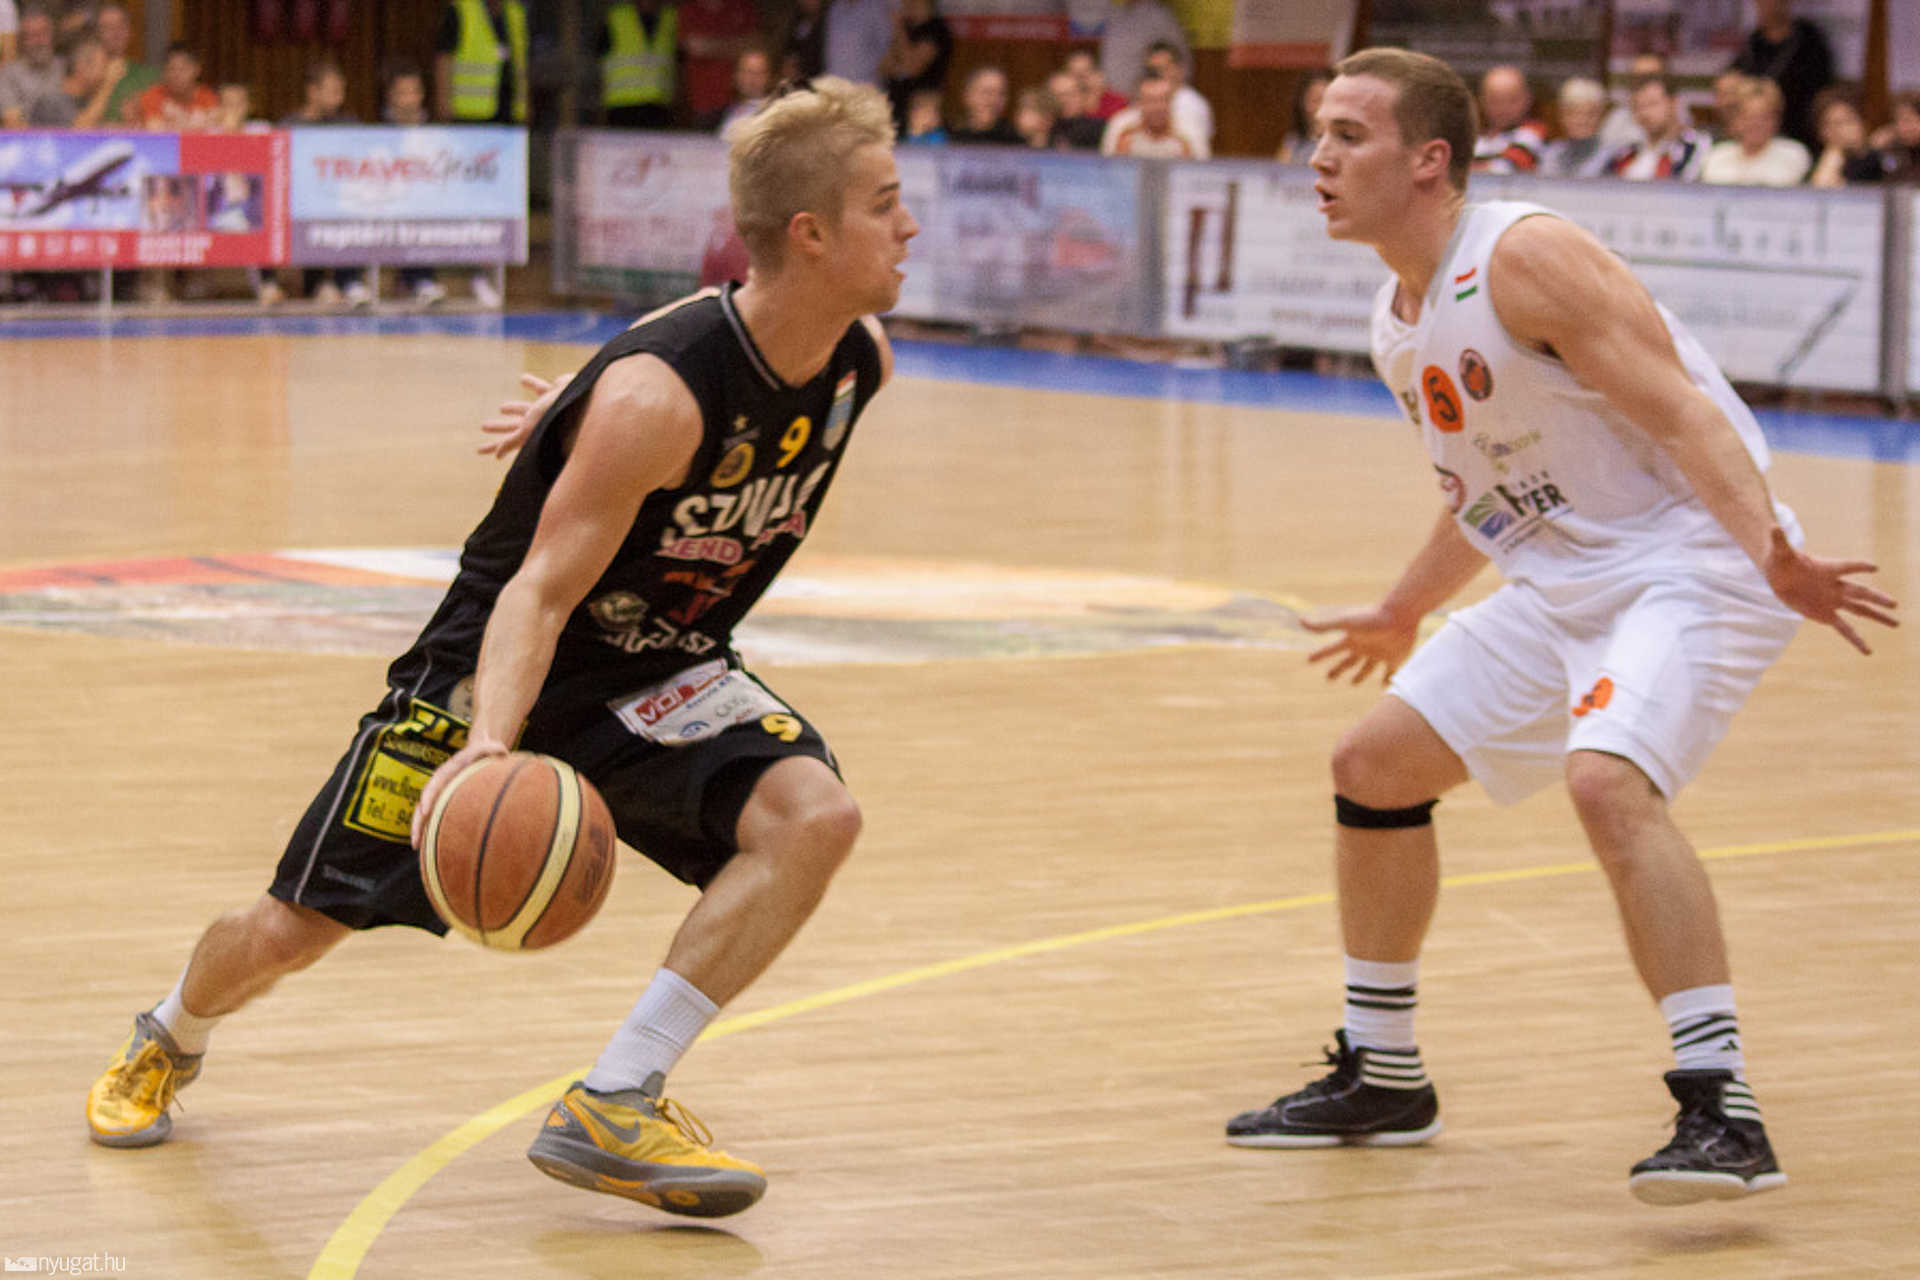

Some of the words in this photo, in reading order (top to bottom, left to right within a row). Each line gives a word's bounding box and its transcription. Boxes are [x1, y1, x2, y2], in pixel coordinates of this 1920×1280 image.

[1428, 375, 1459, 424] 5
[775, 415, 812, 469] 9
[760, 712, 803, 743] 9
